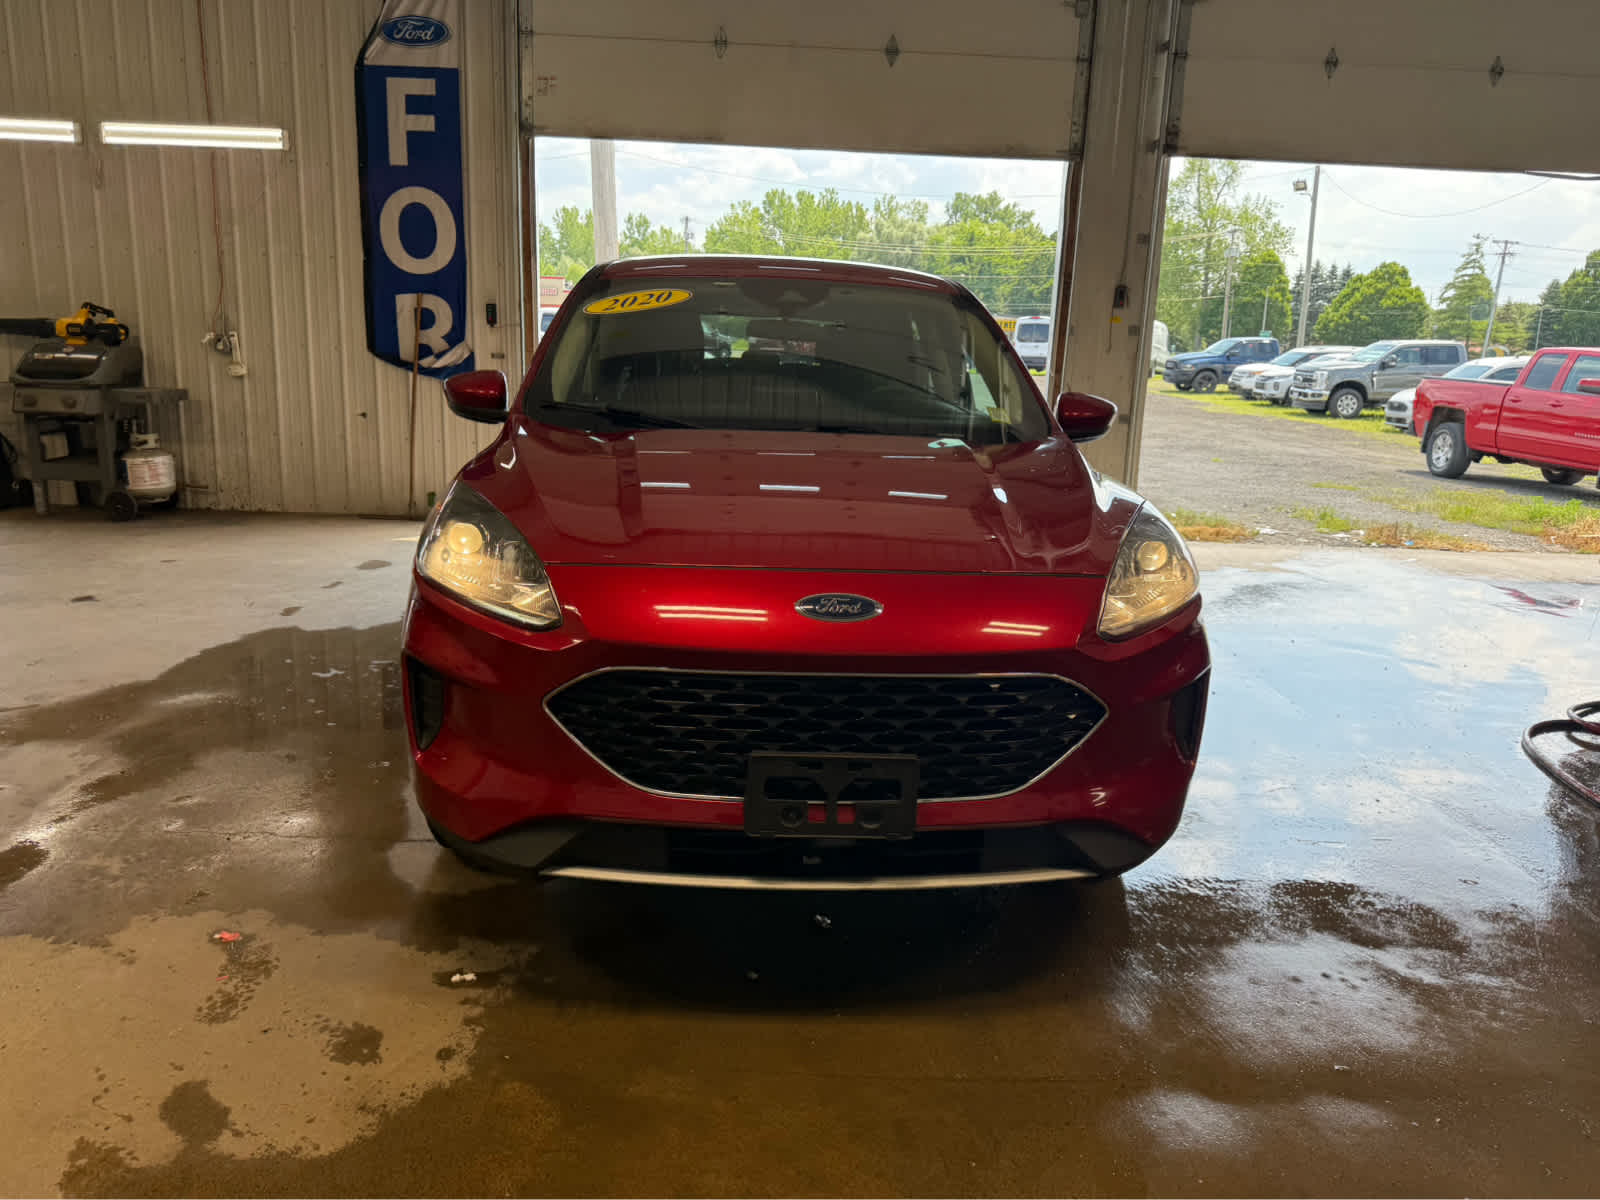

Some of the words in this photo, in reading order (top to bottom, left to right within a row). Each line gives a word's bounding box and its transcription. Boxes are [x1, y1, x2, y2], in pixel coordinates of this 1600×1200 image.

[393, 20, 435, 41] Ford
[602, 290, 672, 311] 2020
[816, 597, 862, 613] Ford
